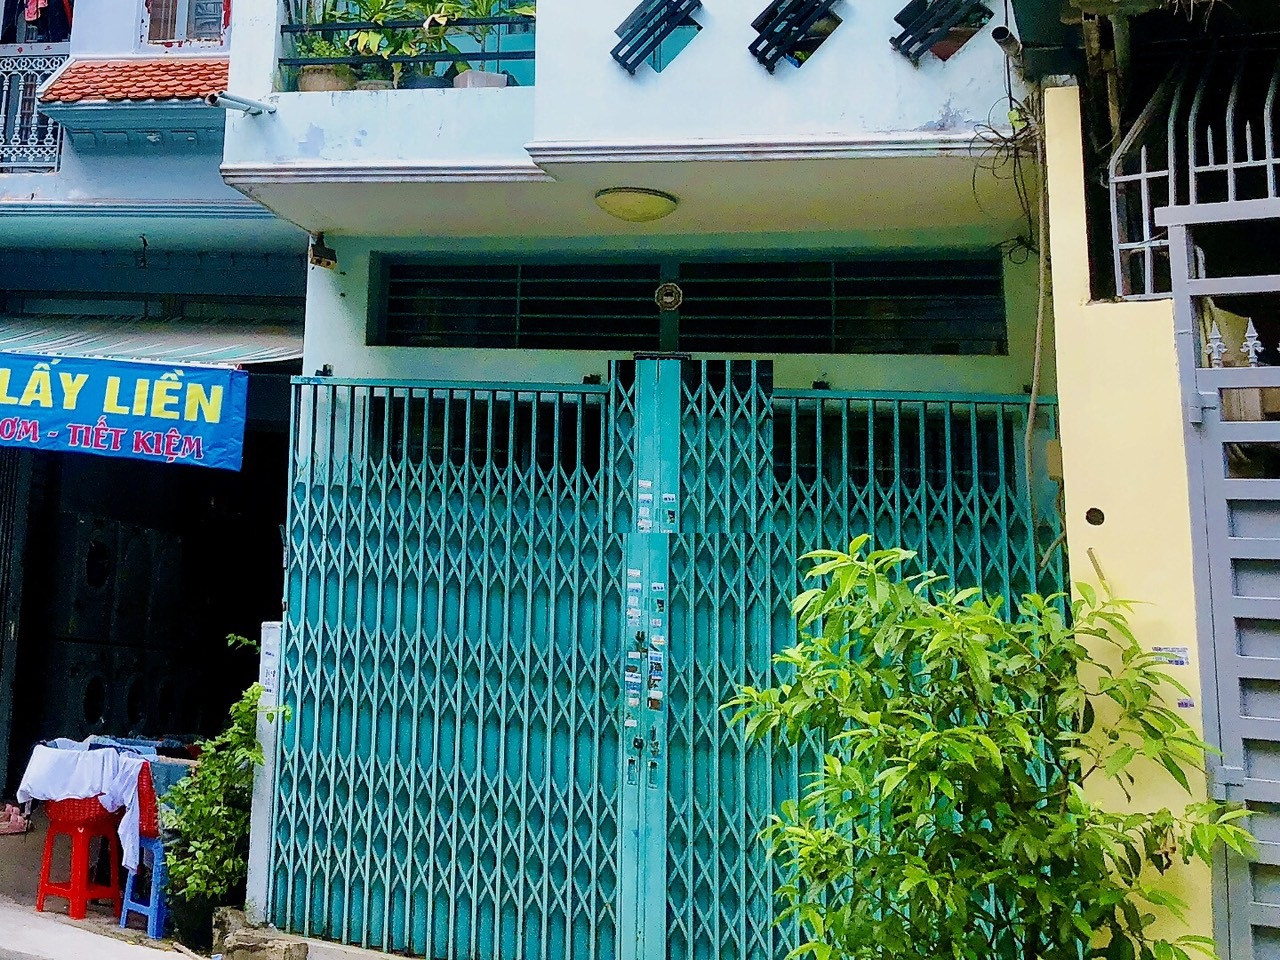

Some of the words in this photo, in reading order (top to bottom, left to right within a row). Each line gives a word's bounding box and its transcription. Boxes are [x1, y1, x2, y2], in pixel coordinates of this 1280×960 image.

[103, 369, 224, 424] LIỀN
[66, 415, 128, 452] TIẾT
[132, 427, 205, 464] KIỆM
